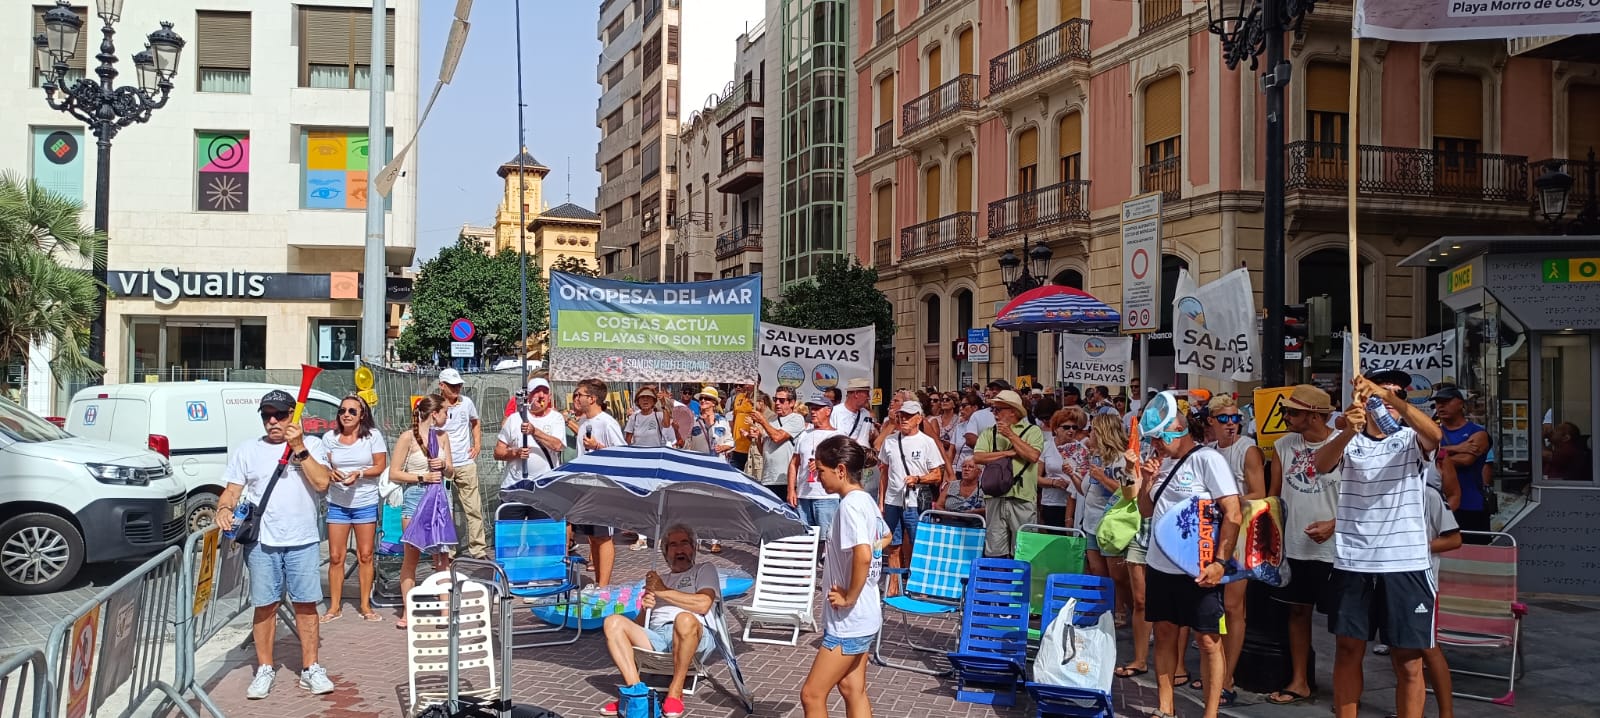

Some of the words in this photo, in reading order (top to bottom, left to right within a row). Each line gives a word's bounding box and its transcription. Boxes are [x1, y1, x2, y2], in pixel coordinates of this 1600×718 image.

[1453, 2, 1487, 14] Playa
[1491, 0, 1531, 11] Morro
[1534, 0, 1552, 9] de
[1454, 267, 1470, 288] ONCE
[559, 284, 658, 305] OROPESA
[663, 289, 701, 305] DEL
[707, 288, 752, 304] MAR
[596, 316, 660, 331] COSTAS
[665, 316, 719, 331] ACTÚA
[563, 331, 590, 342] LAS
[594, 332, 645, 344] PLAYAS
[649, 334, 669, 345] NO
[673, 335, 701, 345] SON
[705, 335, 746, 346] TUYAS
[765, 329, 856, 345] SALVEMOS
[761, 344, 790, 357] LAS
[794, 347, 859, 362] PLAYAS
[1177, 349, 1216, 370] LAS
[1065, 361, 1124, 372] SALVEMOS
[1360, 357, 1380, 370] AS
[1381, 354, 1453, 370] PLAYAS
[1084, 372, 1126, 383] PLAYAS
